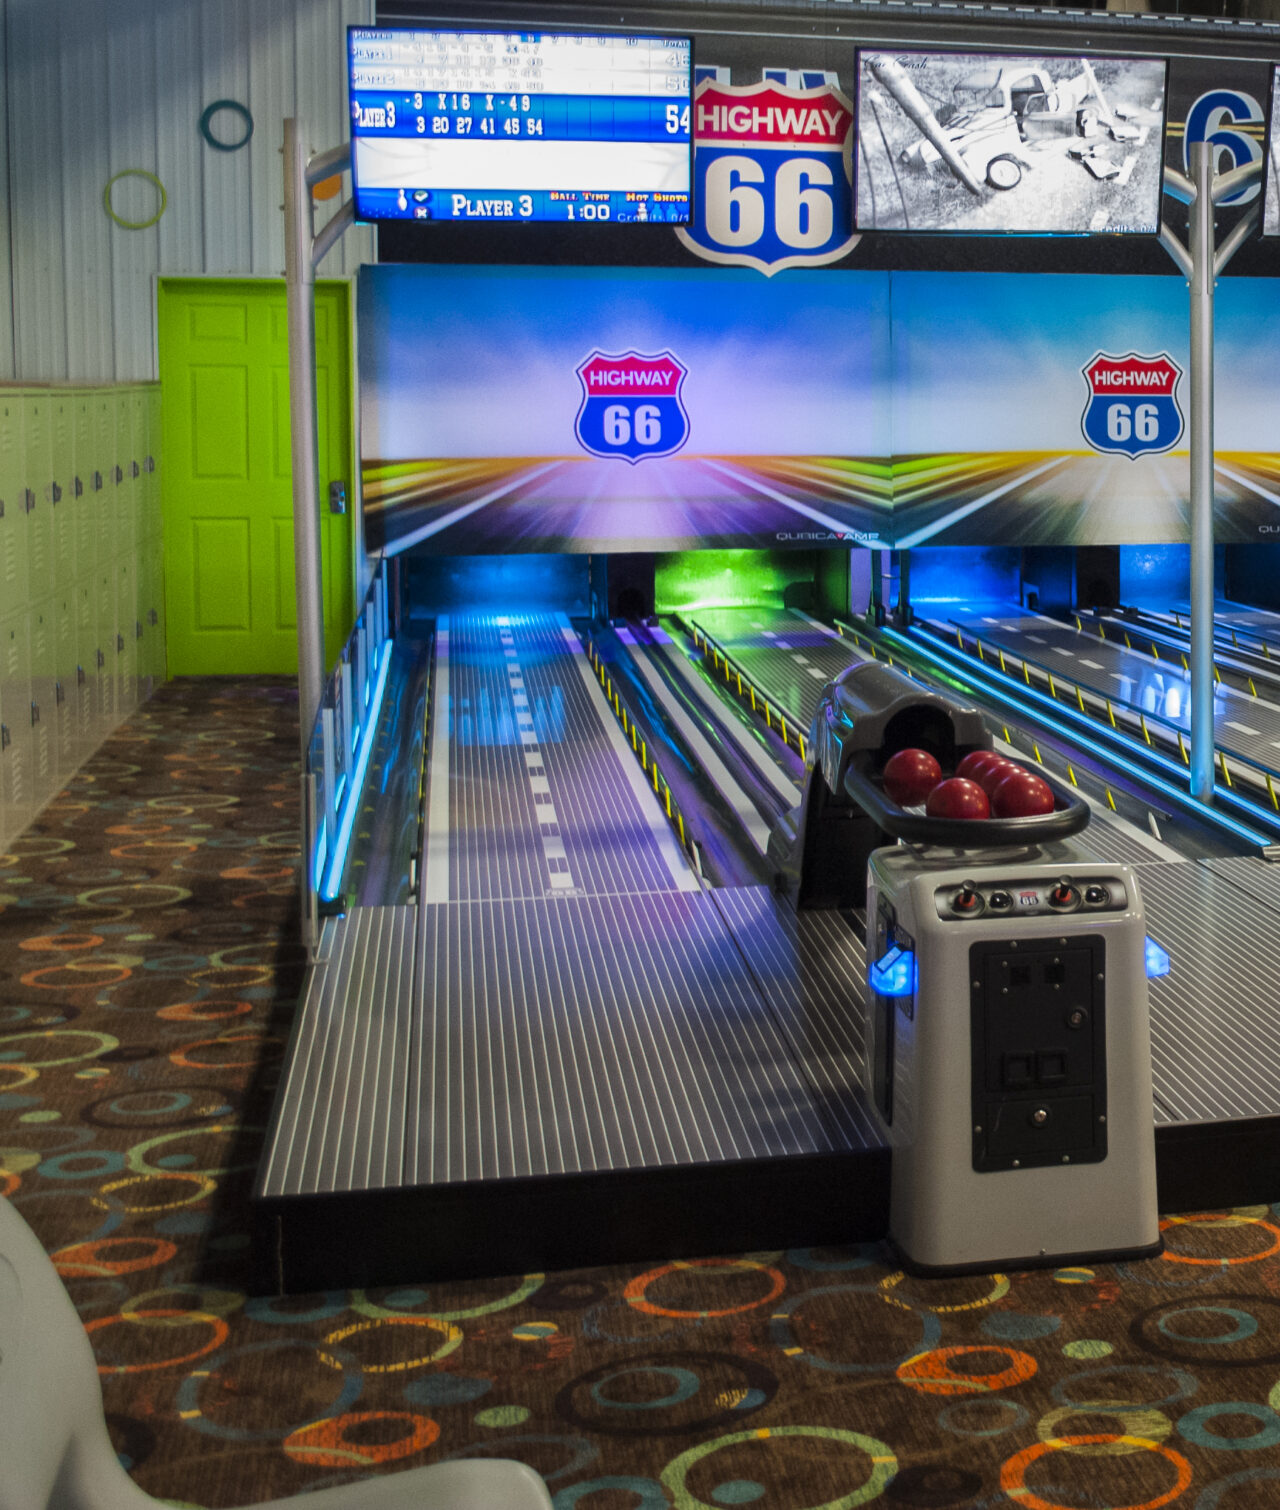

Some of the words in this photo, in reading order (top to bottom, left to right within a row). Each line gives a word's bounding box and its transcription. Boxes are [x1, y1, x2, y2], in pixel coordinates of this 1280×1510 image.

[414, 93, 423, 109] 3
[438, 94, 446, 110] X
[452, 94, 458, 110] 1
[486, 94, 494, 110] X
[509, 95, 517, 111] 4
[522, 95, 531, 111] 9
[417, 116, 425, 133] 3
[432, 116, 449, 133] 20
[456, 117, 473, 134] 27
[480, 118, 495, 134] 41
[504, 118, 520, 135] 45
[527, 118, 543, 135] 54
[666, 105, 690, 134] 54
[697, 104, 844, 136] HIGHWAY
[519, 194, 534, 217] 3
[705, 155, 833, 249] 66
[590, 370, 673, 386] HIGHWAY
[1094, 370, 1170, 386] HIGHWAY
[603, 404, 661, 446] 66
[1107, 403, 1159, 442] 66
